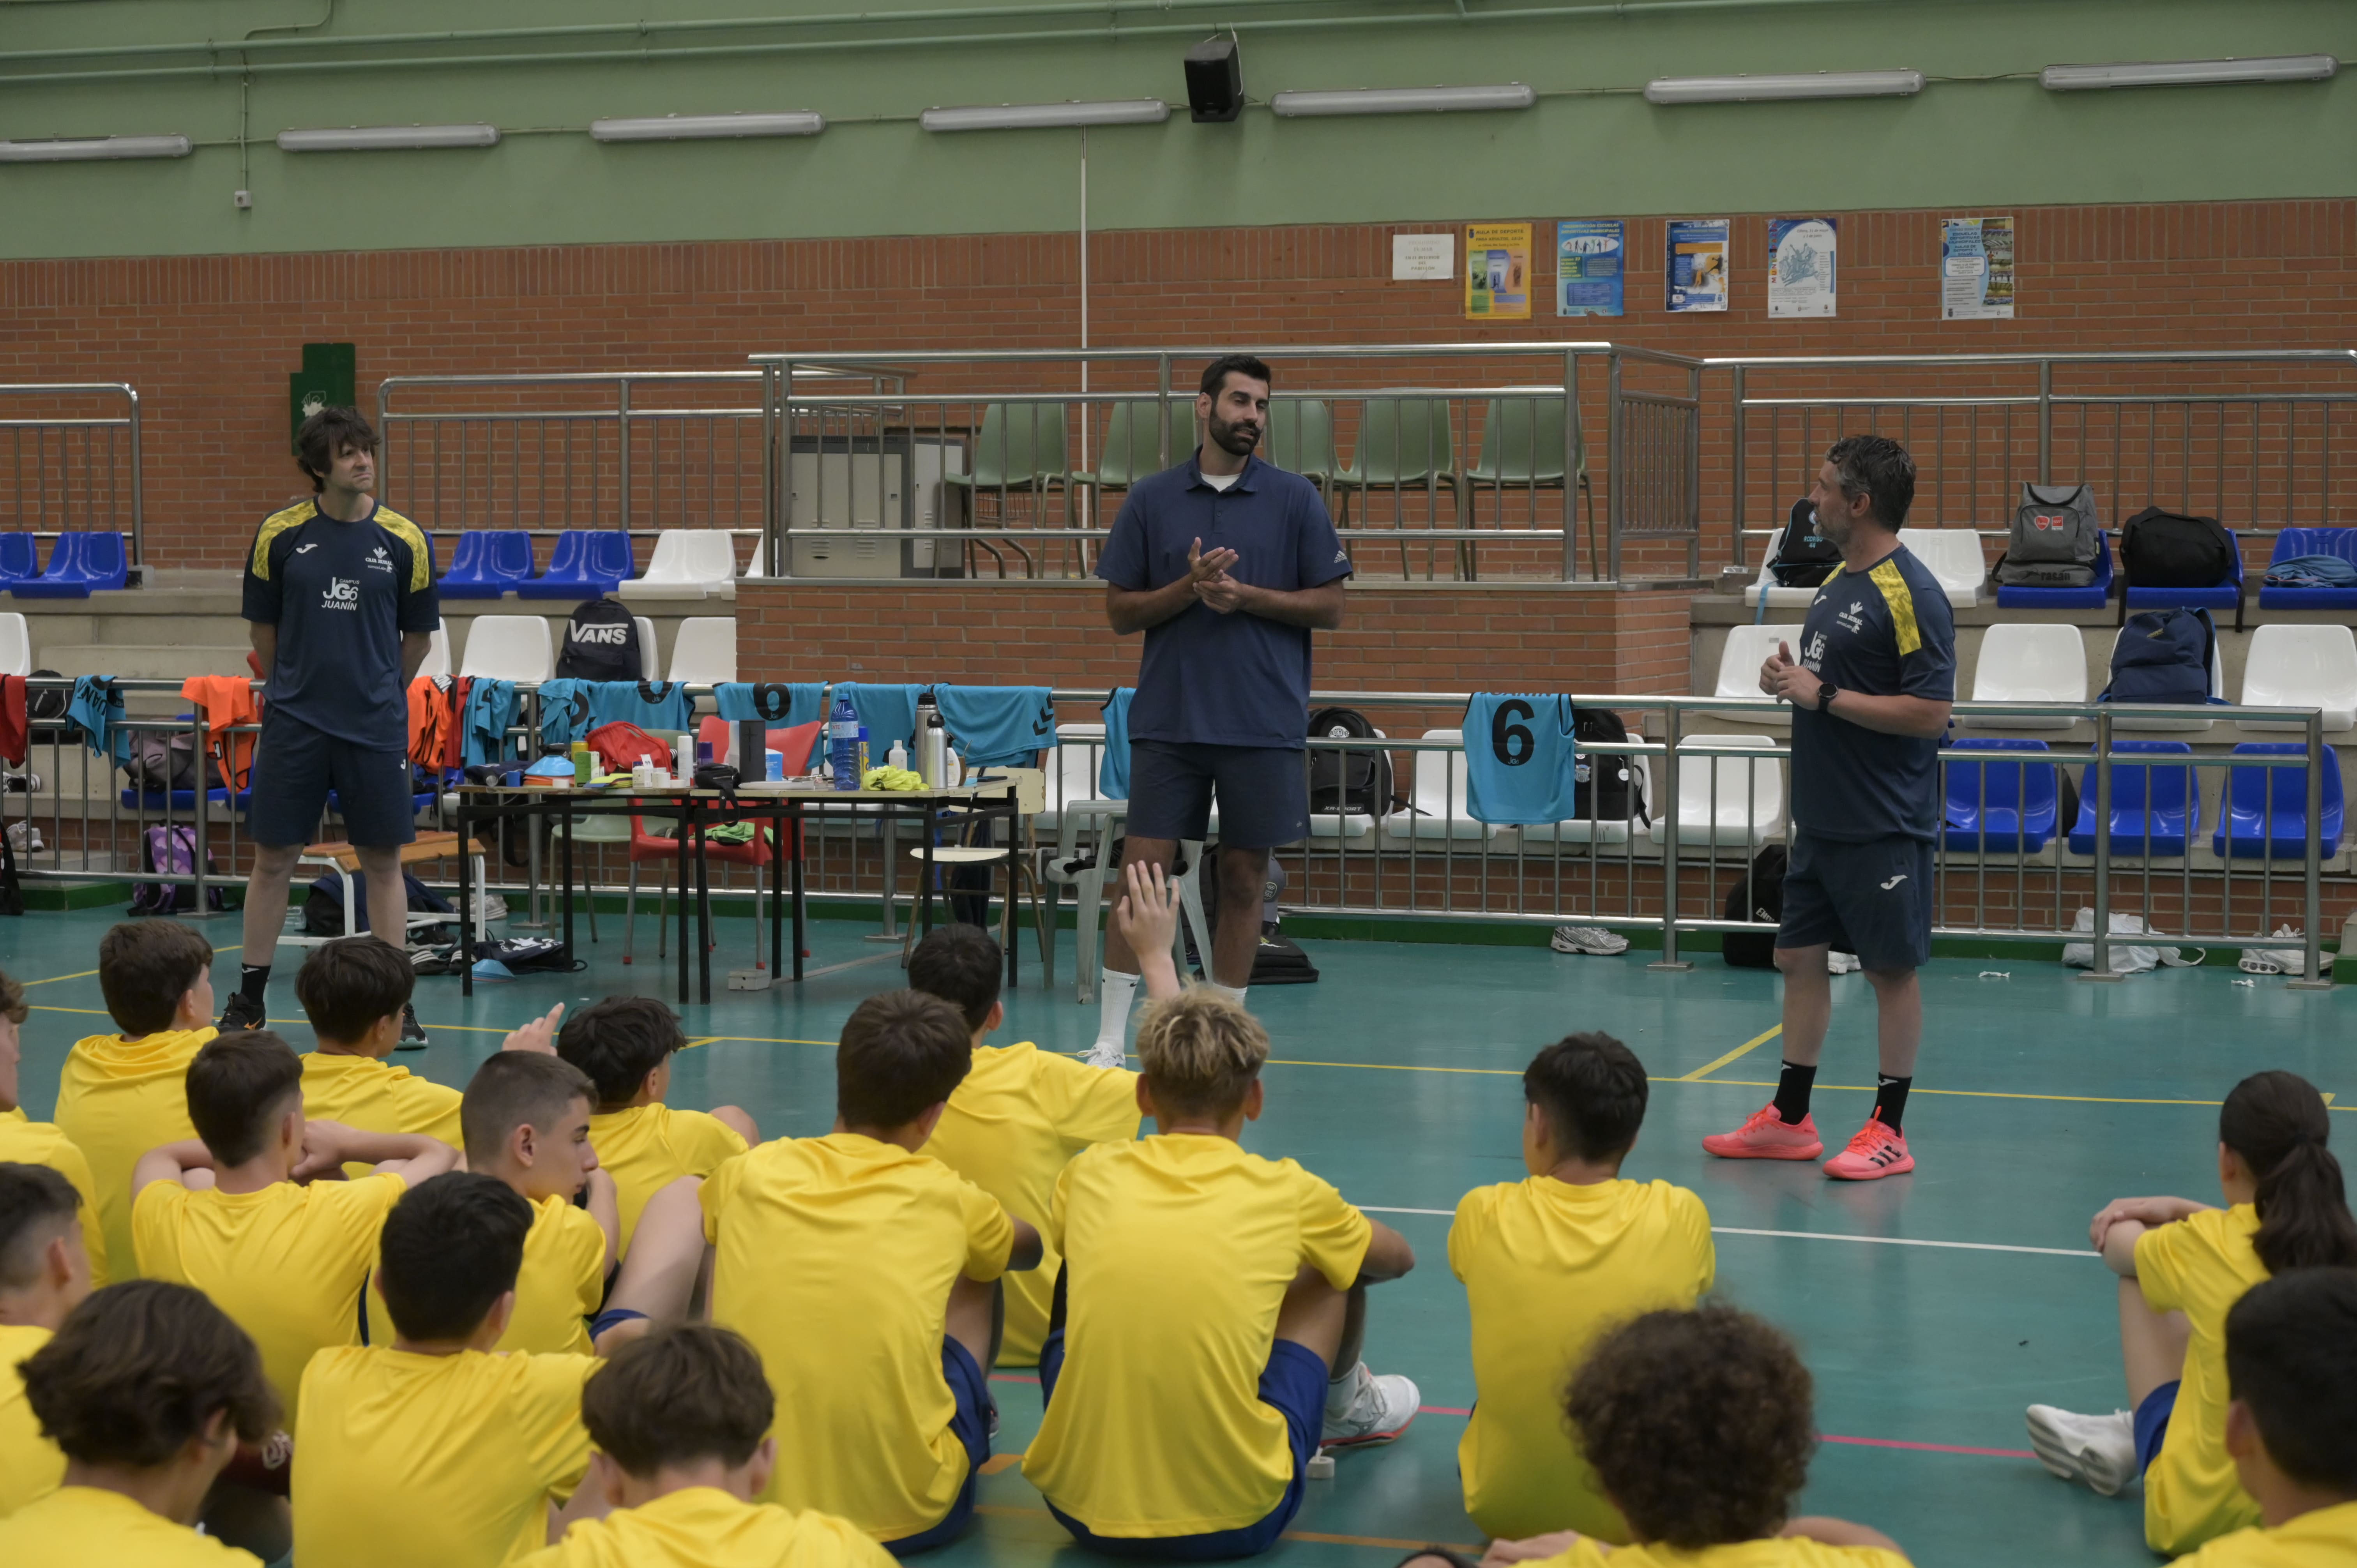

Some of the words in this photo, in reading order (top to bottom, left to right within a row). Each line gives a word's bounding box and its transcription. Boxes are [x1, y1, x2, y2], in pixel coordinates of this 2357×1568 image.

[323, 577, 359, 601] JG6
[321, 600, 357, 611] JUANÍN
[570, 619, 628, 645] VANS
[1848, 615, 1862, 626] RURAL
[1805, 630, 1825, 660] JG6
[1492, 699, 1535, 766] 6
